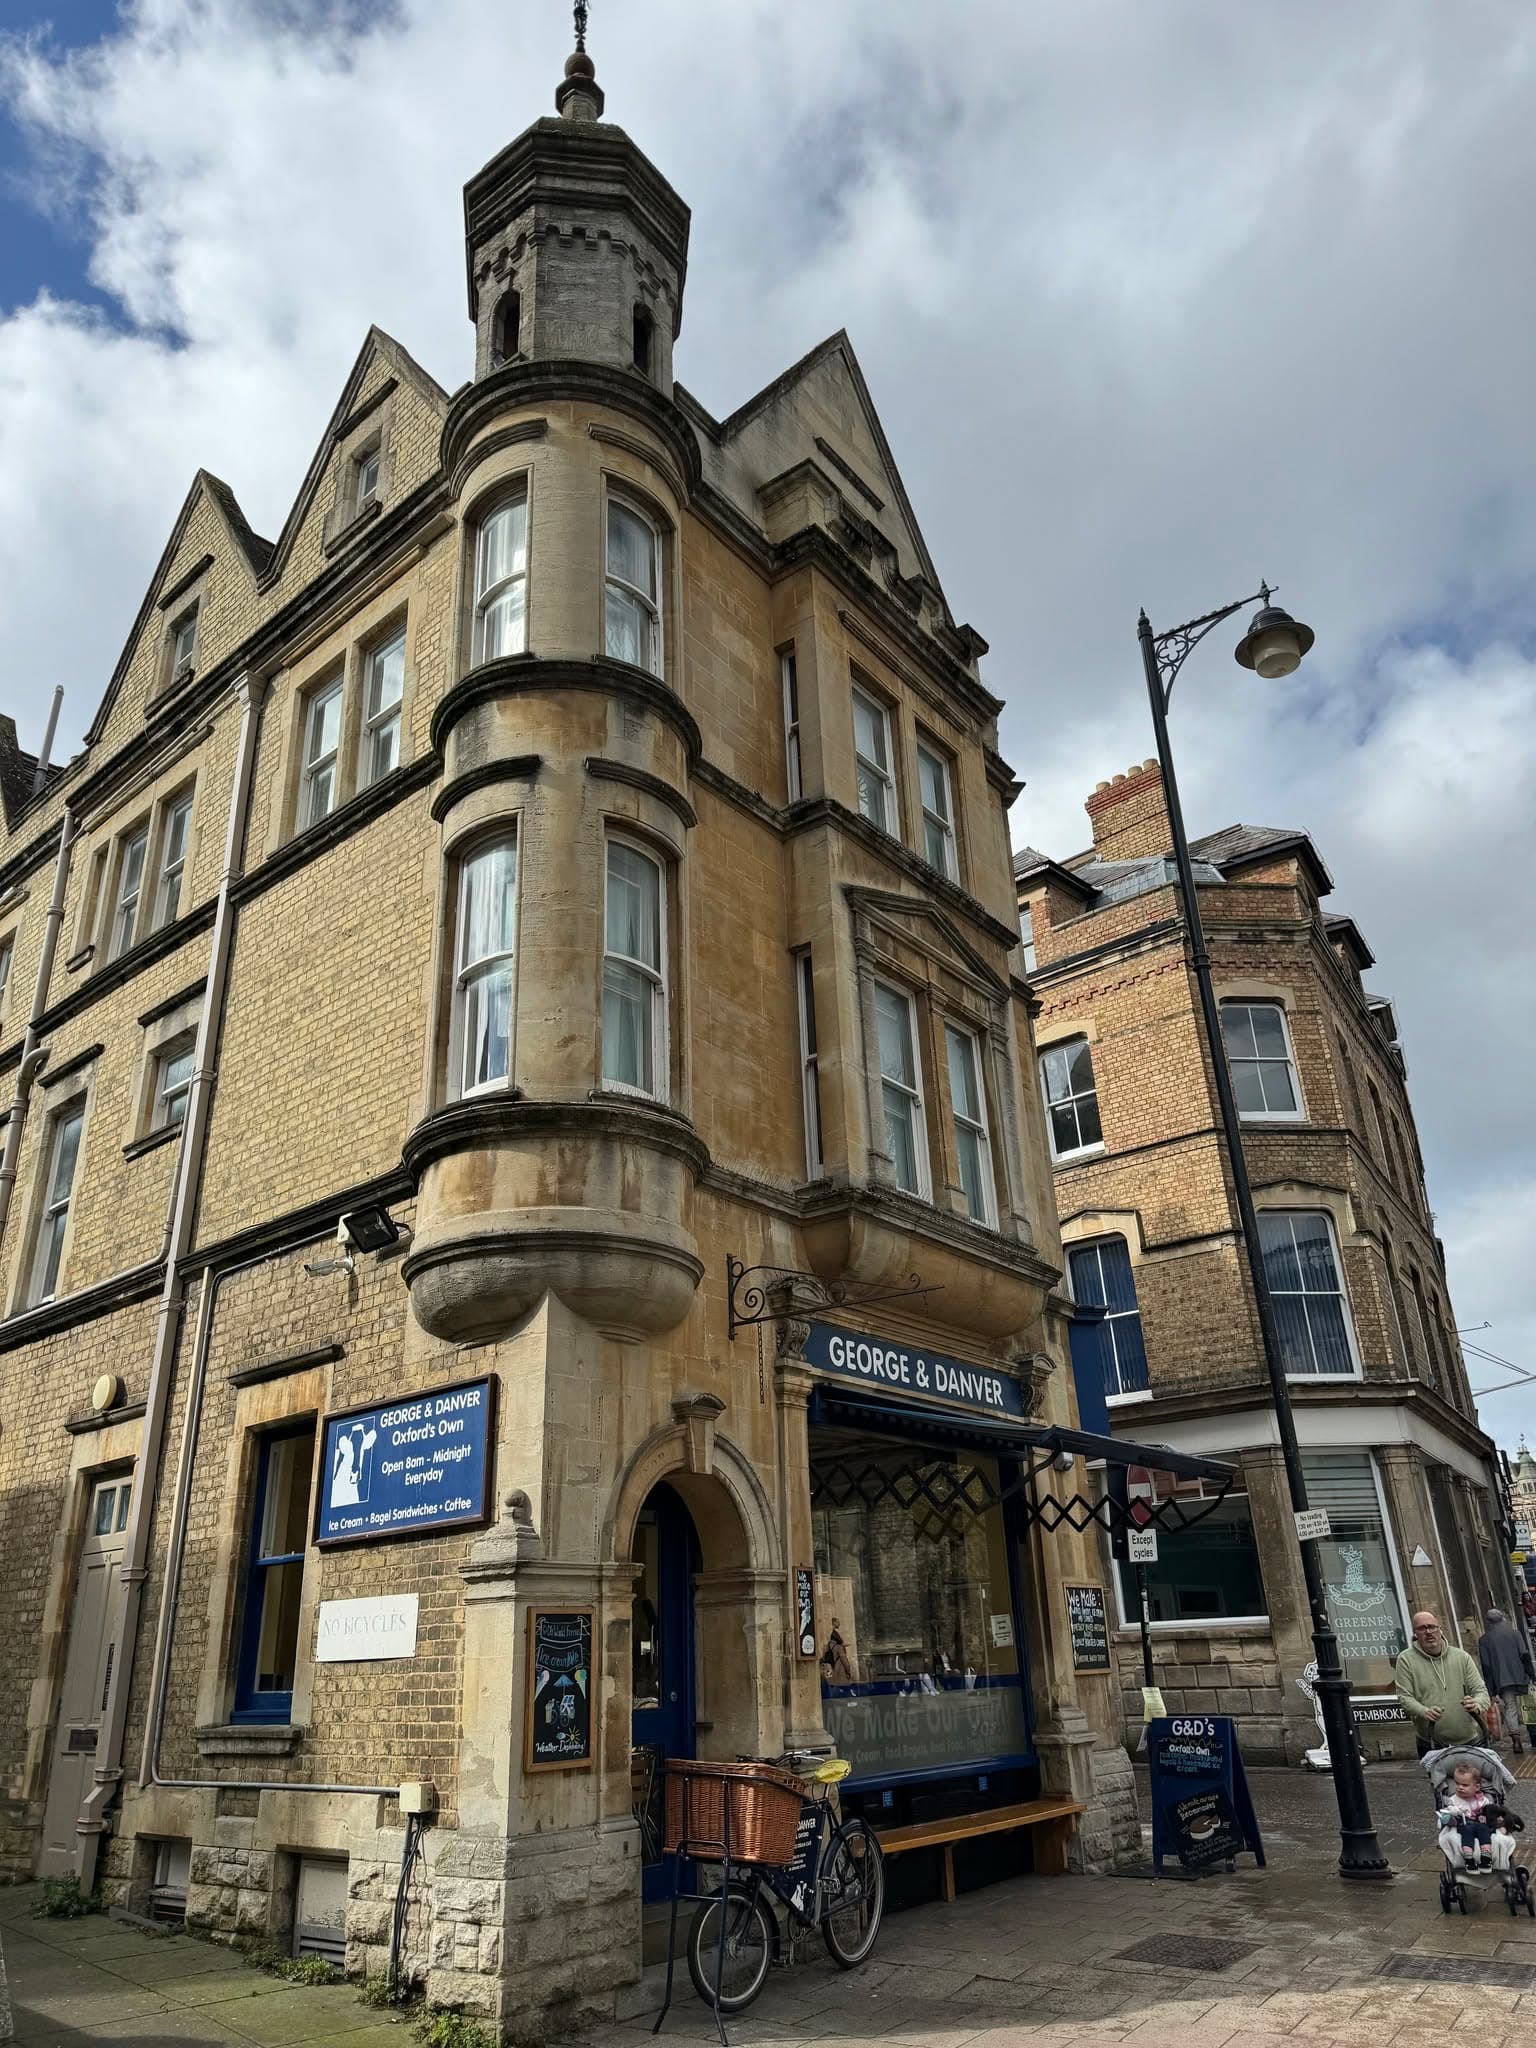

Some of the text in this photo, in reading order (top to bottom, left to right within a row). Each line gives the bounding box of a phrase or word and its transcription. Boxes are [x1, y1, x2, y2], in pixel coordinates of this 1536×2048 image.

[829, 1336, 1004, 1407] GEORGE & DANVER
[380, 1390, 481, 1428] GEORGE & DANVER
[392, 1419, 464, 1446] Oxford's Own
[381, 1460, 404, 1476] Open
[405, 1455, 425, 1468] 8am
[432, 1444, 472, 1463] Midnight
[405, 1467, 444, 1486] Everyday
[329, 1498, 472, 1531] Ice Cream Bagel Sandwiches Coffee
[1131, 1534, 1153, 1546] Except
[1133, 1548, 1154, 1560] cycles
[798, 1571, 807, 1582] We
[1066, 1588, 1080, 1607] We
[1335, 1615, 1394, 1628] GREENE'S
[1337, 1630, 1396, 1643] COLLEGE
[1340, 1645, 1399, 1657] OXFORD
[863, 1699, 920, 1740] Make
[1353, 1708, 1407, 1722] PEMBROKE
[1172, 1718, 1215, 1736] G&D's
[535, 1742, 559, 1753] Weather
